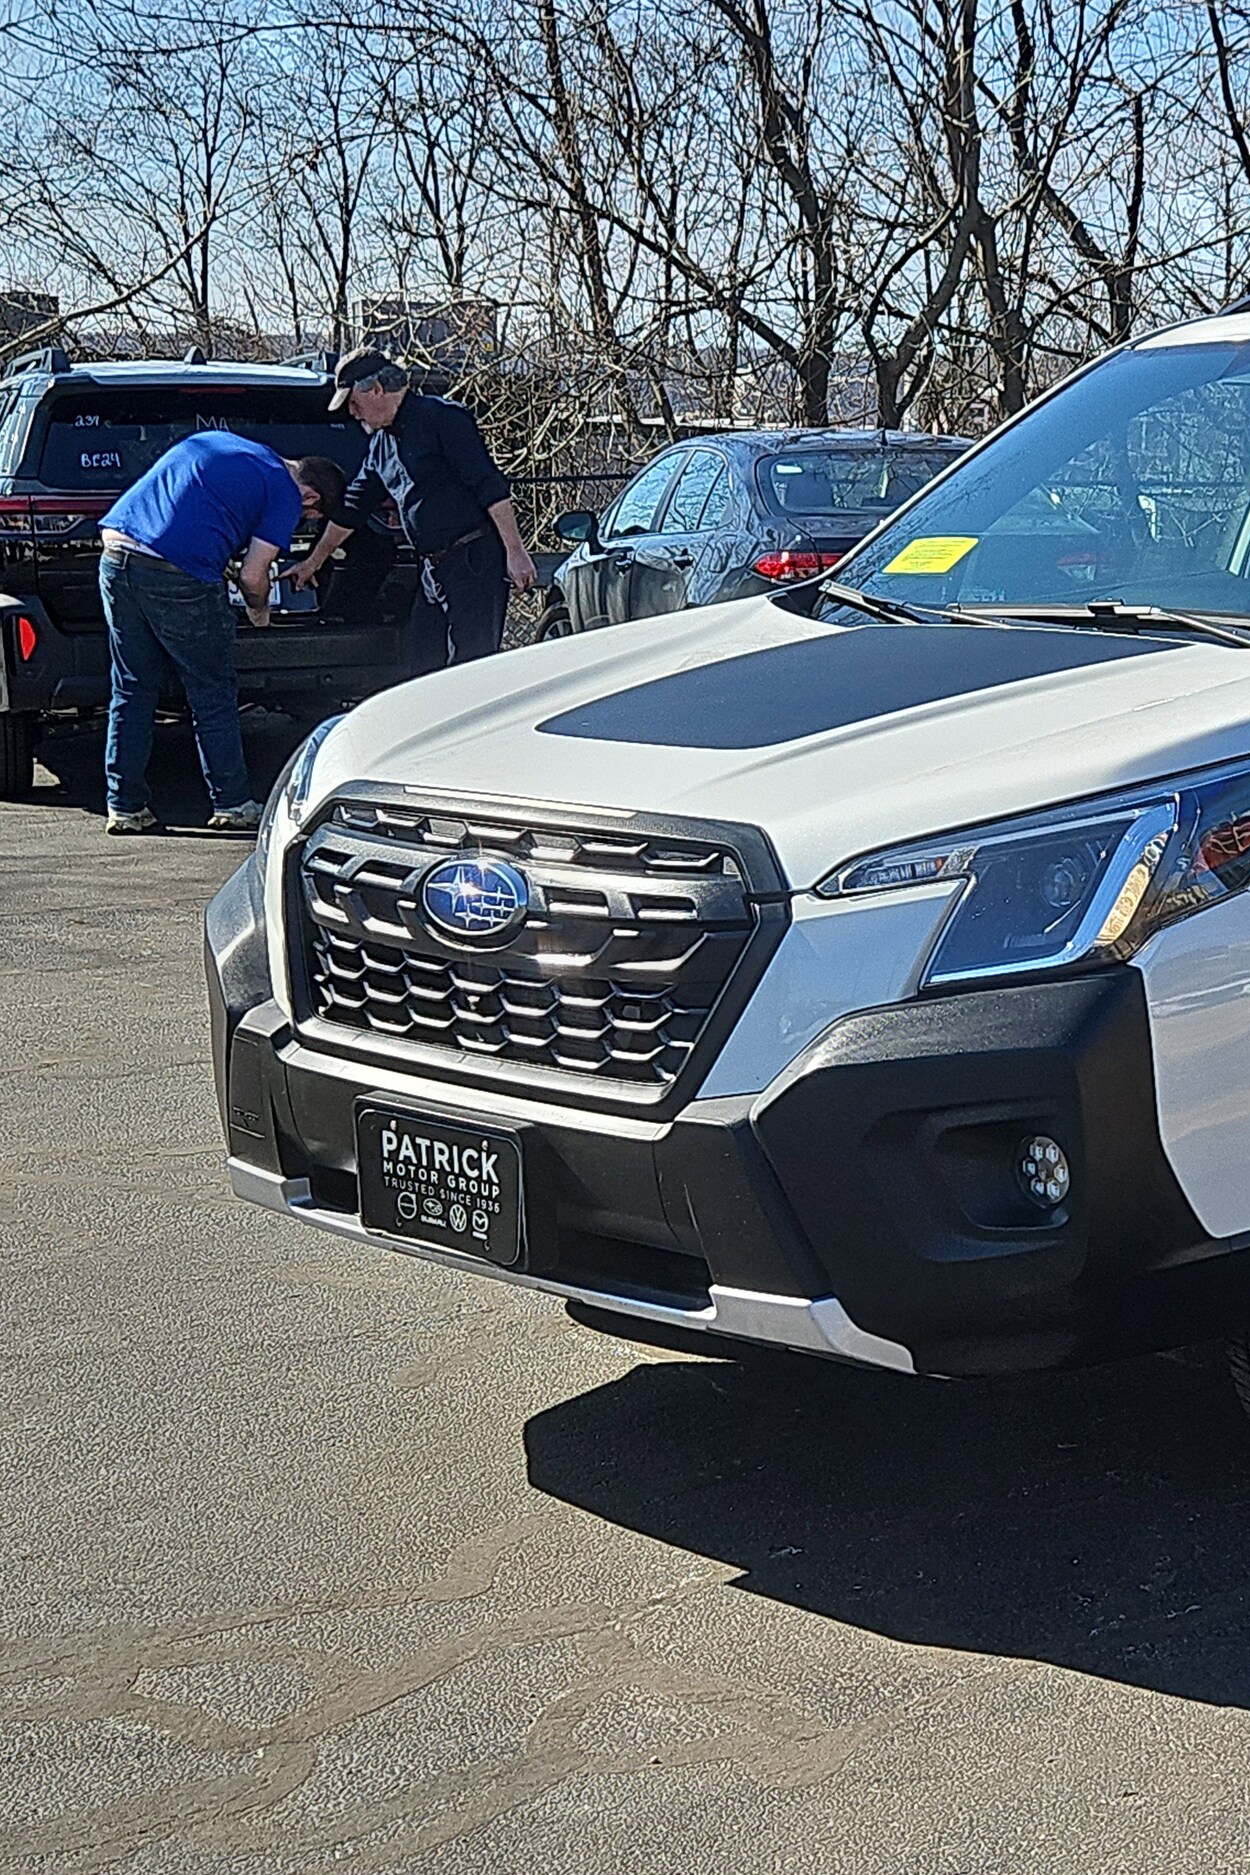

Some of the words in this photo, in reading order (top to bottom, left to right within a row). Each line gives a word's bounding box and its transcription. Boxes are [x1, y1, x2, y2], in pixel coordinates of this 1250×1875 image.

[381, 1130, 499, 1183] PATRICK
[383, 1161, 439, 1184] MOTOR
[447, 1175, 500, 1199] GROUP
[384, 1176, 435, 1196] TRUSTED
[439, 1188, 472, 1206] SINCE
[476, 1198, 500, 1214] 1936
